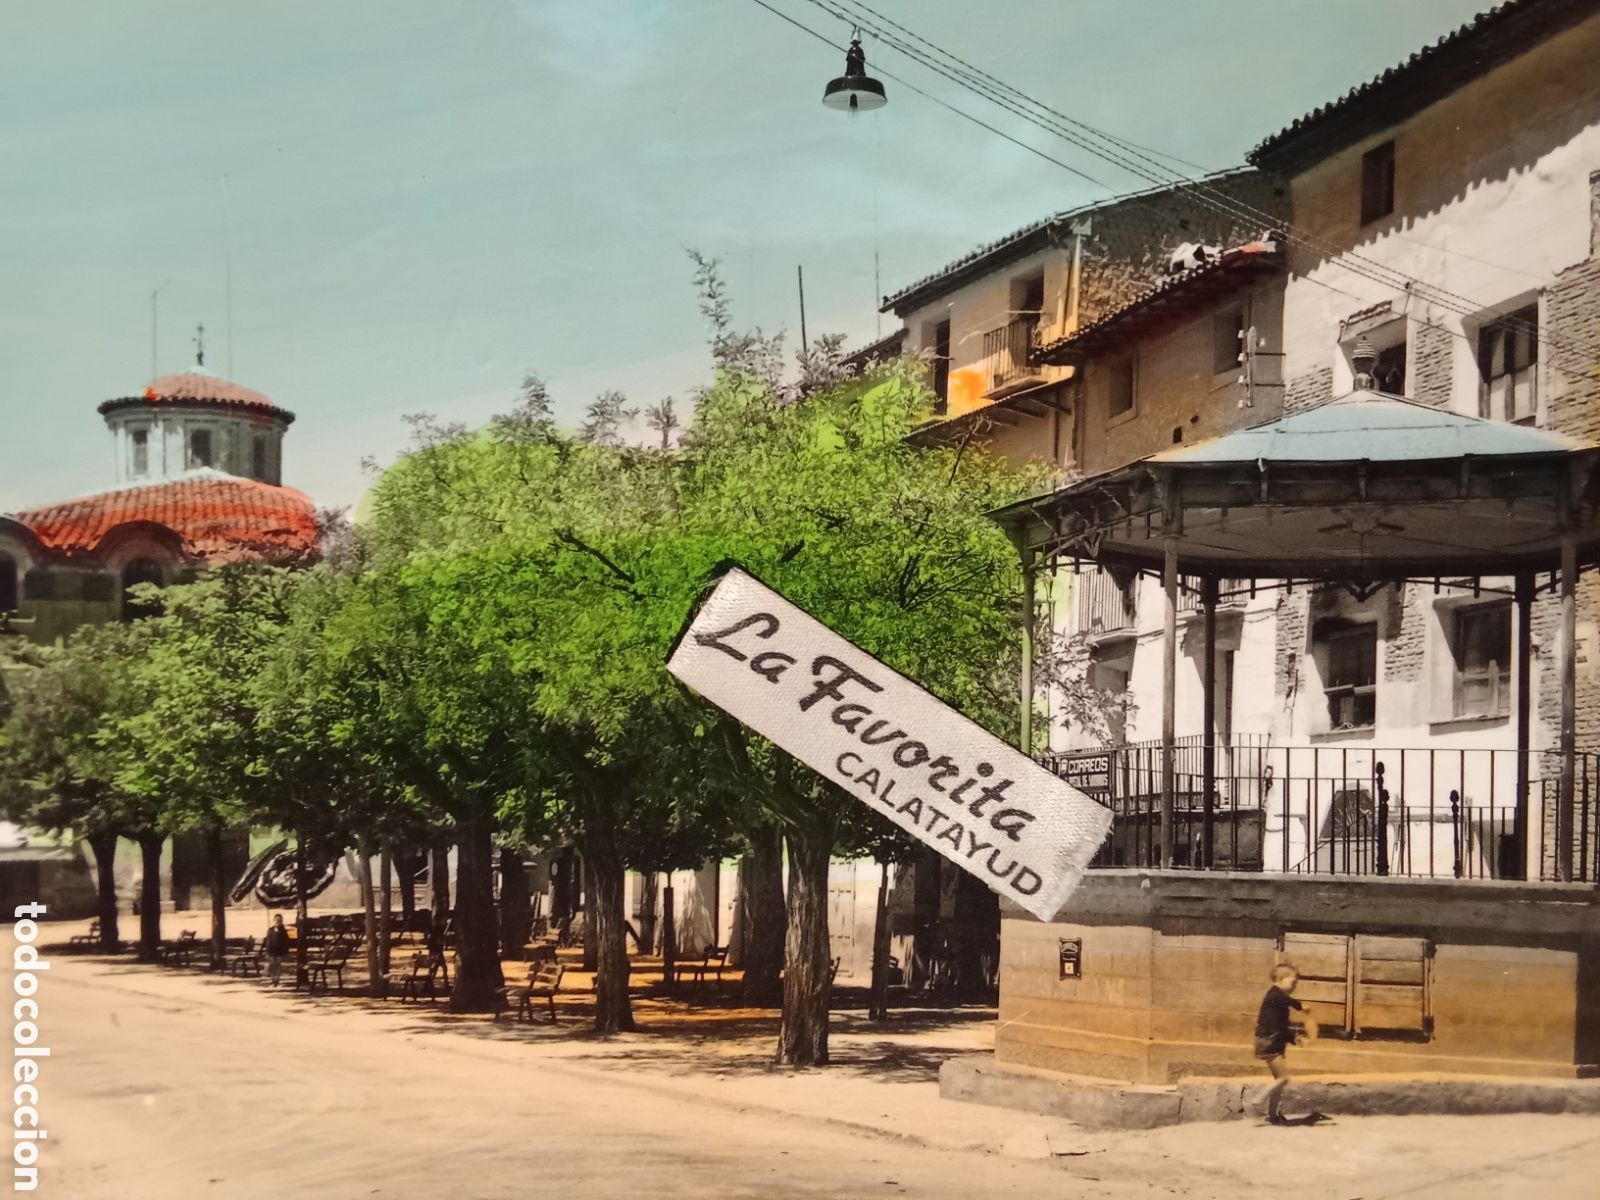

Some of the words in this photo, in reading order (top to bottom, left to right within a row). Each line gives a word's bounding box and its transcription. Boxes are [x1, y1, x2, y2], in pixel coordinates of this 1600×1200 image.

[694, 612, 797, 685] La
[799, 655, 1037, 842] Favorita
[1068, 757, 1109, 774] CORREOS
[836, 752, 1043, 895] CALATAYUD
